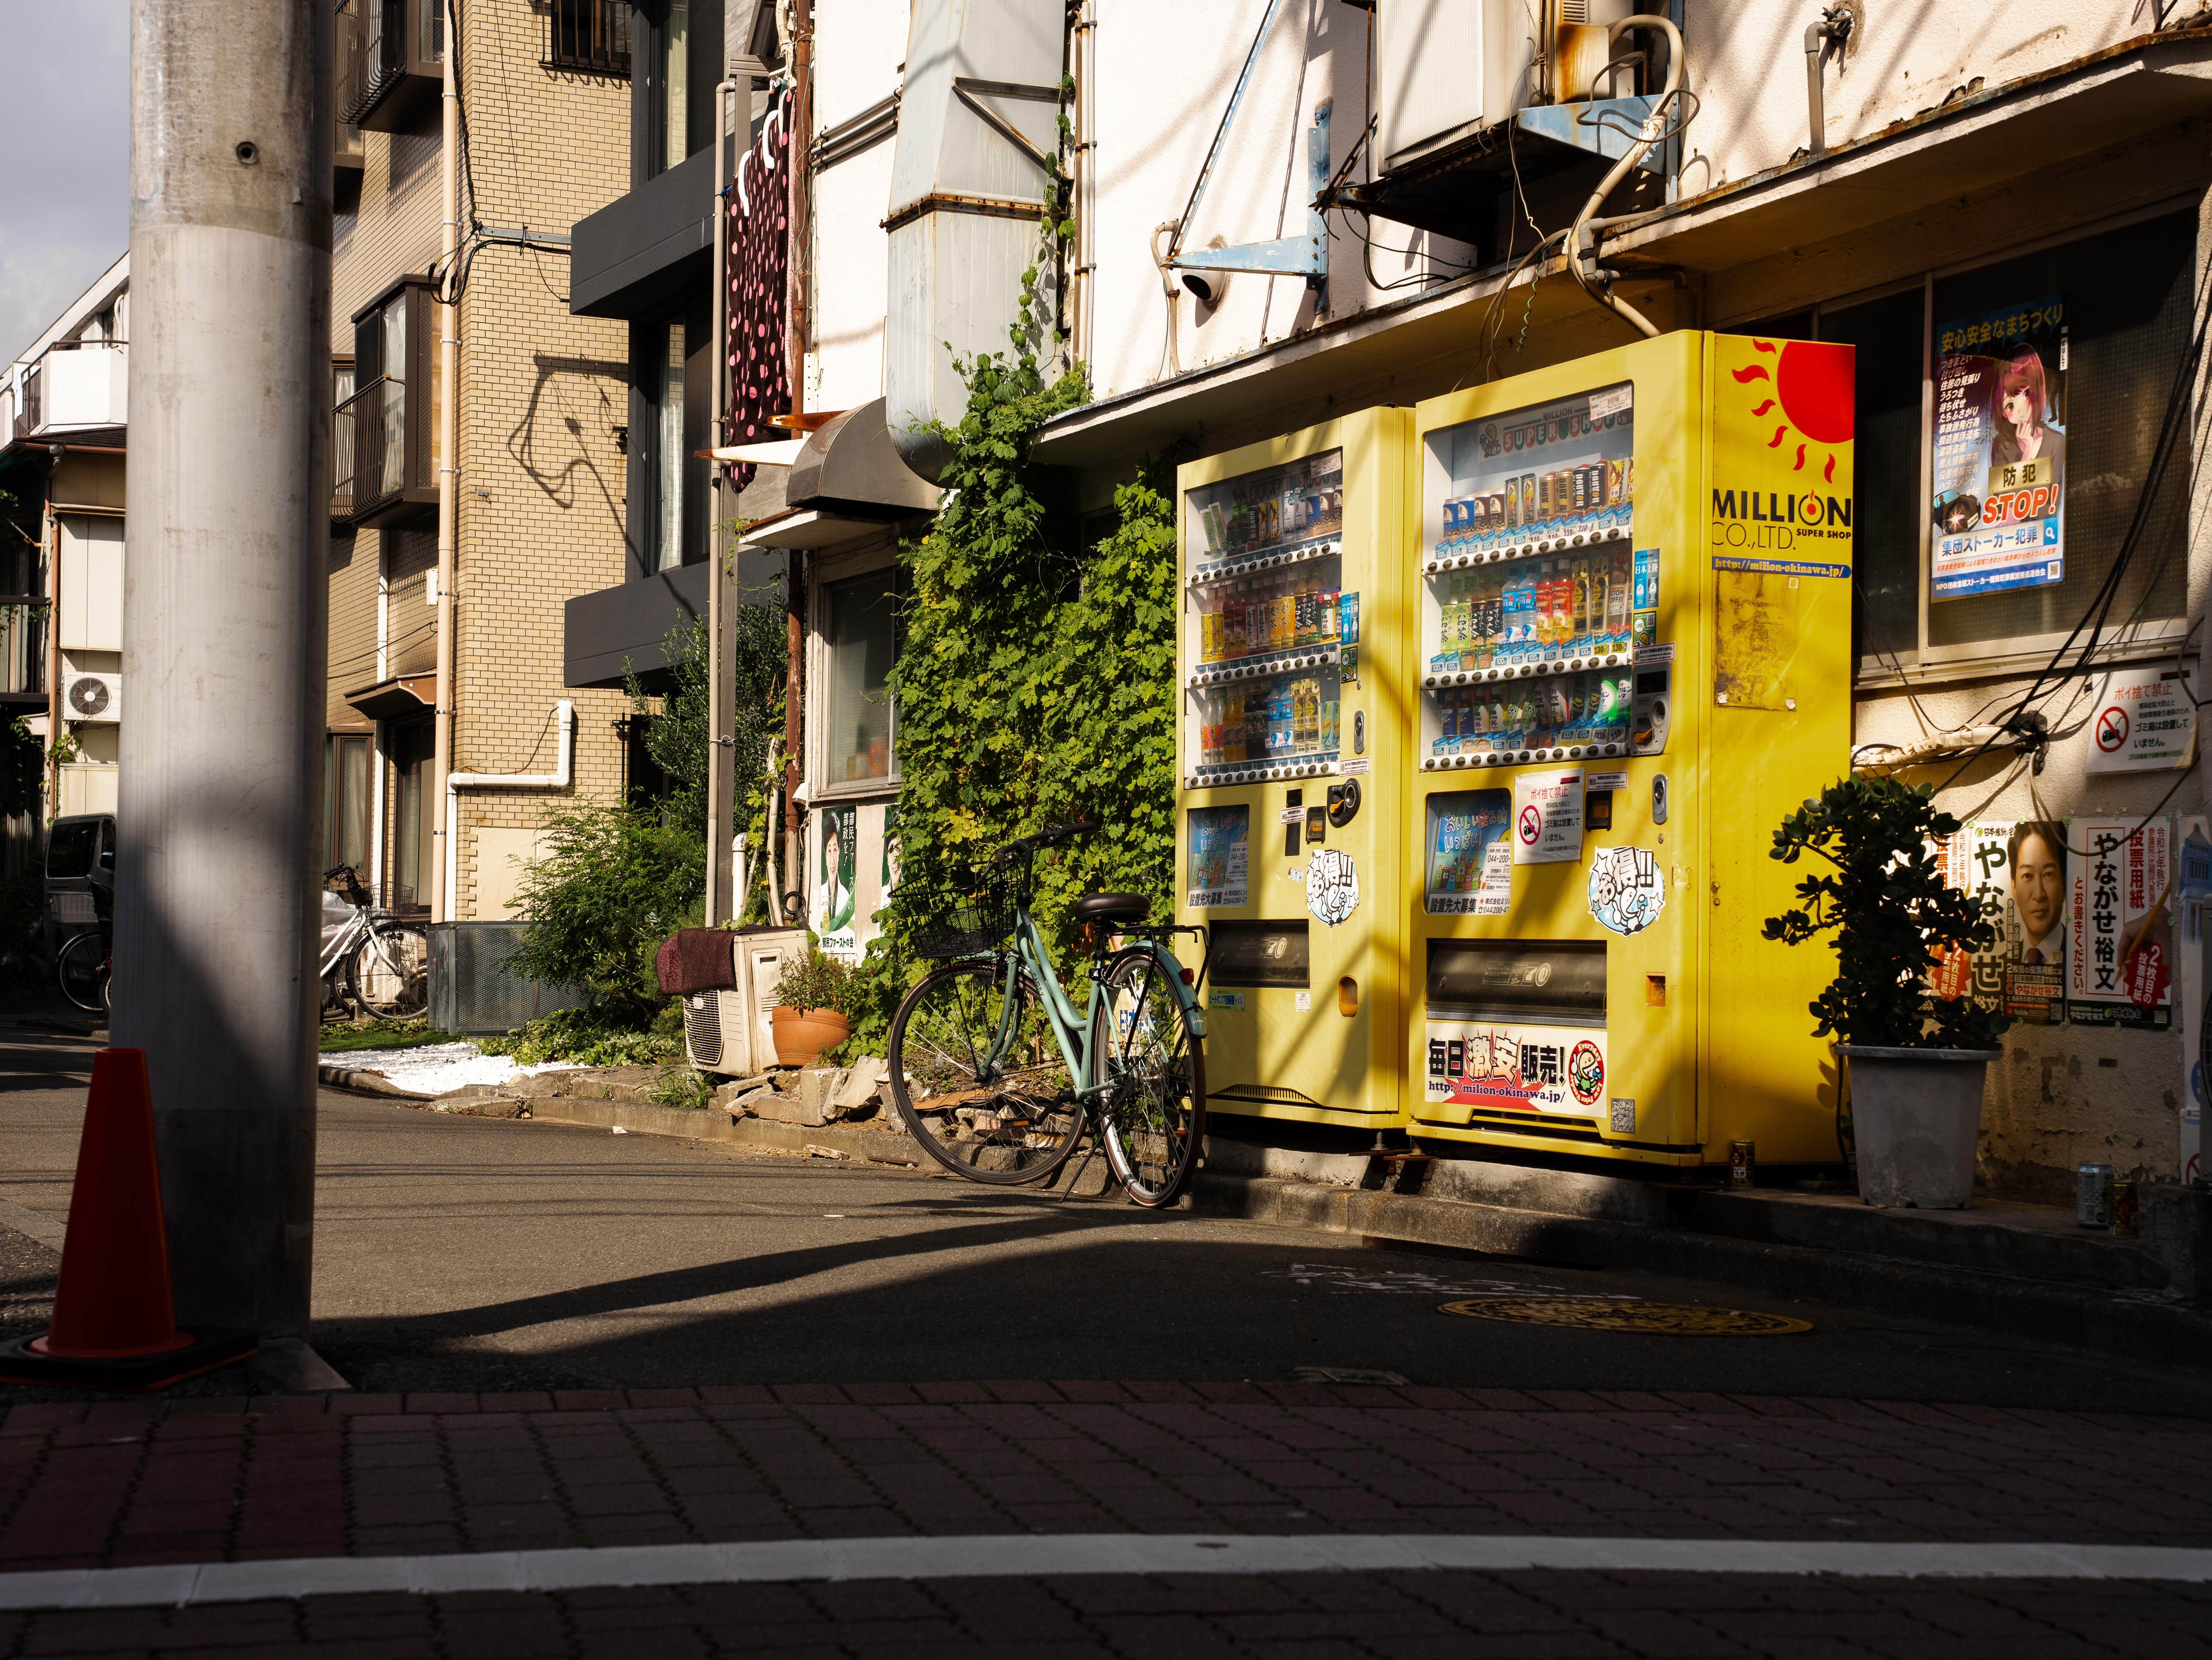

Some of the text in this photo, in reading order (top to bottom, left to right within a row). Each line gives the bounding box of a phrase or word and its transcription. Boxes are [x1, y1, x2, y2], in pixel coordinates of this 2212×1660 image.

[1942, 304, 2062, 352] 安心安全なまちづくり
[1940, 373, 1981, 391] 住居の見張り
[1941, 366, 1967, 380] 付け回し
[1608, 396, 1619, 405] 810748
[1940, 387, 1965, 401] うろつき
[1543, 406, 1573, 421] MILLION
[1939, 398, 1966, 413] 待ち伏せ
[1939, 406, 1979, 423] たちふさがり
[1505, 423, 1556, 448] SUPER
[1938, 452, 1980, 469] 個人情報共有
[1939, 464, 1980, 480] 位置情報共有
[2003, 464, 2036, 487] 防犯
[1938, 475, 1976, 490] ハラスメント
[1559, 478, 1567, 510] DOUTOR
[1713, 489, 1852, 527] MILLION
[1982, 484, 2059, 525] STOP!
[1797, 528, 1851, 539] SUPER SHOP
[1942, 525, 2037, 556] 集団ストーカー犯罪
[1635, 563, 1658, 574] 日本上陸
[1715, 559, 1844, 577] http://milion-okinawa.jp/
[1269, 606, 1278, 631] 麦茶
[1281, 603, 1288, 628] 麦茶
[1342, 604, 1358, 615] 日本上陸
[1457, 614, 1468, 641] お茶
[2115, 682, 2172, 701] ポイ捨て禁止
[2135, 719, 2188, 732] ゴミ箱は設置して
[2134, 738, 2165, 748] いません。
[1531, 786, 1568, 800] ポイ捨て禁止
[1202, 813, 1247, 837] おいしい飲み物
[1445, 807, 1508, 833] おいしい飲み物
[1545, 818, 1580, 829] ゴミ箱は設置して
[1201, 833, 1228, 855] いっぱい!
[1444, 830, 1483, 854] いっぱい!
[1545, 833, 1565, 842] いません。
[2157, 827, 2165, 890] 令和七年執行
[2129, 827, 2144, 909] 投票用紙
[1189, 891, 1223, 906] 設置先大募集
[1429, 898, 1477, 913] 設置先大募集
[2092, 833, 2119, 991] やながせ裕文
[822, 937, 853, 948] 都民ファーストの会
[2073, 876, 2083, 995] とお書きください。
[2007, 963, 2062, 974] 2枚目の投票用紙には
[2133, 952, 2148, 1001] 投票用紙
[2143, 945, 2160, 1003] 2枚目の
[2016, 985, 2060, 996] やながせ裕文
[1428, 1035, 1566, 1087] 毎日激安販売!
[1578, 1043, 1601, 1062] Everyday
[1428, 1080, 1566, 1104] http://milion-okinawa.jp/
[1581, 1096, 1594, 1104] Price
